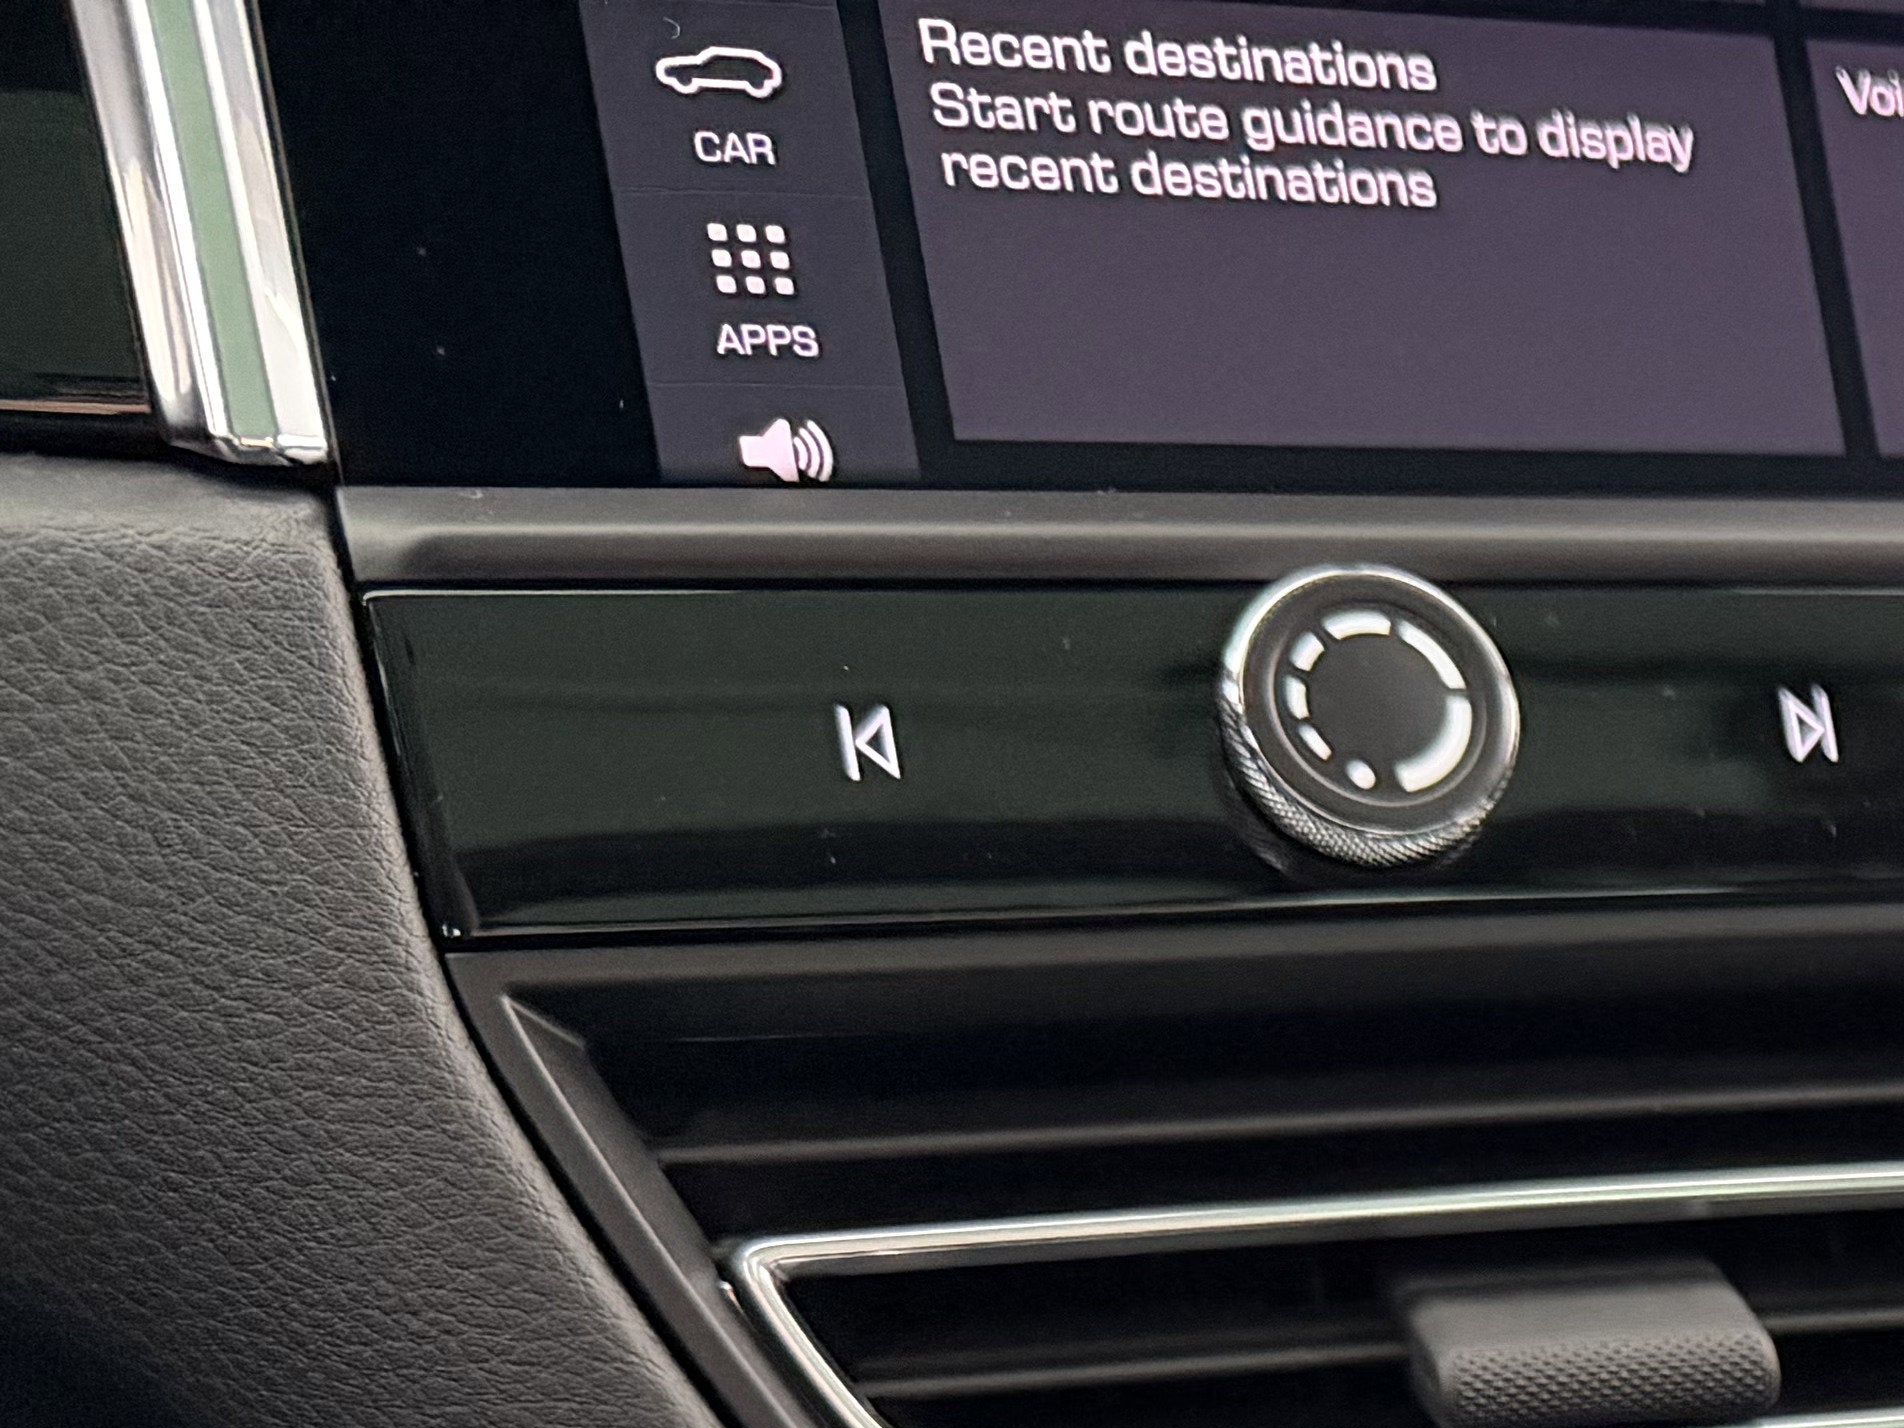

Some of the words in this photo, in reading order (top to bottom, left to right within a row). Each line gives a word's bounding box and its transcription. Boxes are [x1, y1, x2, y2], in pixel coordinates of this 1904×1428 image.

[917, 17, 1111, 74] Recent
[1124, 30, 1437, 92] destinations
[693, 130, 776, 166] CAR
[929, 81, 1076, 134] Start
[1089, 98, 1229, 140] route
[1241, 100, 1463, 152] guidance
[1470, 108, 1528, 155] to
[1536, 107, 1693, 173] display
[940, 150, 1119, 194] recent
[1131, 150, 1437, 208] destinations
[716, 322, 821, 358] APPS
